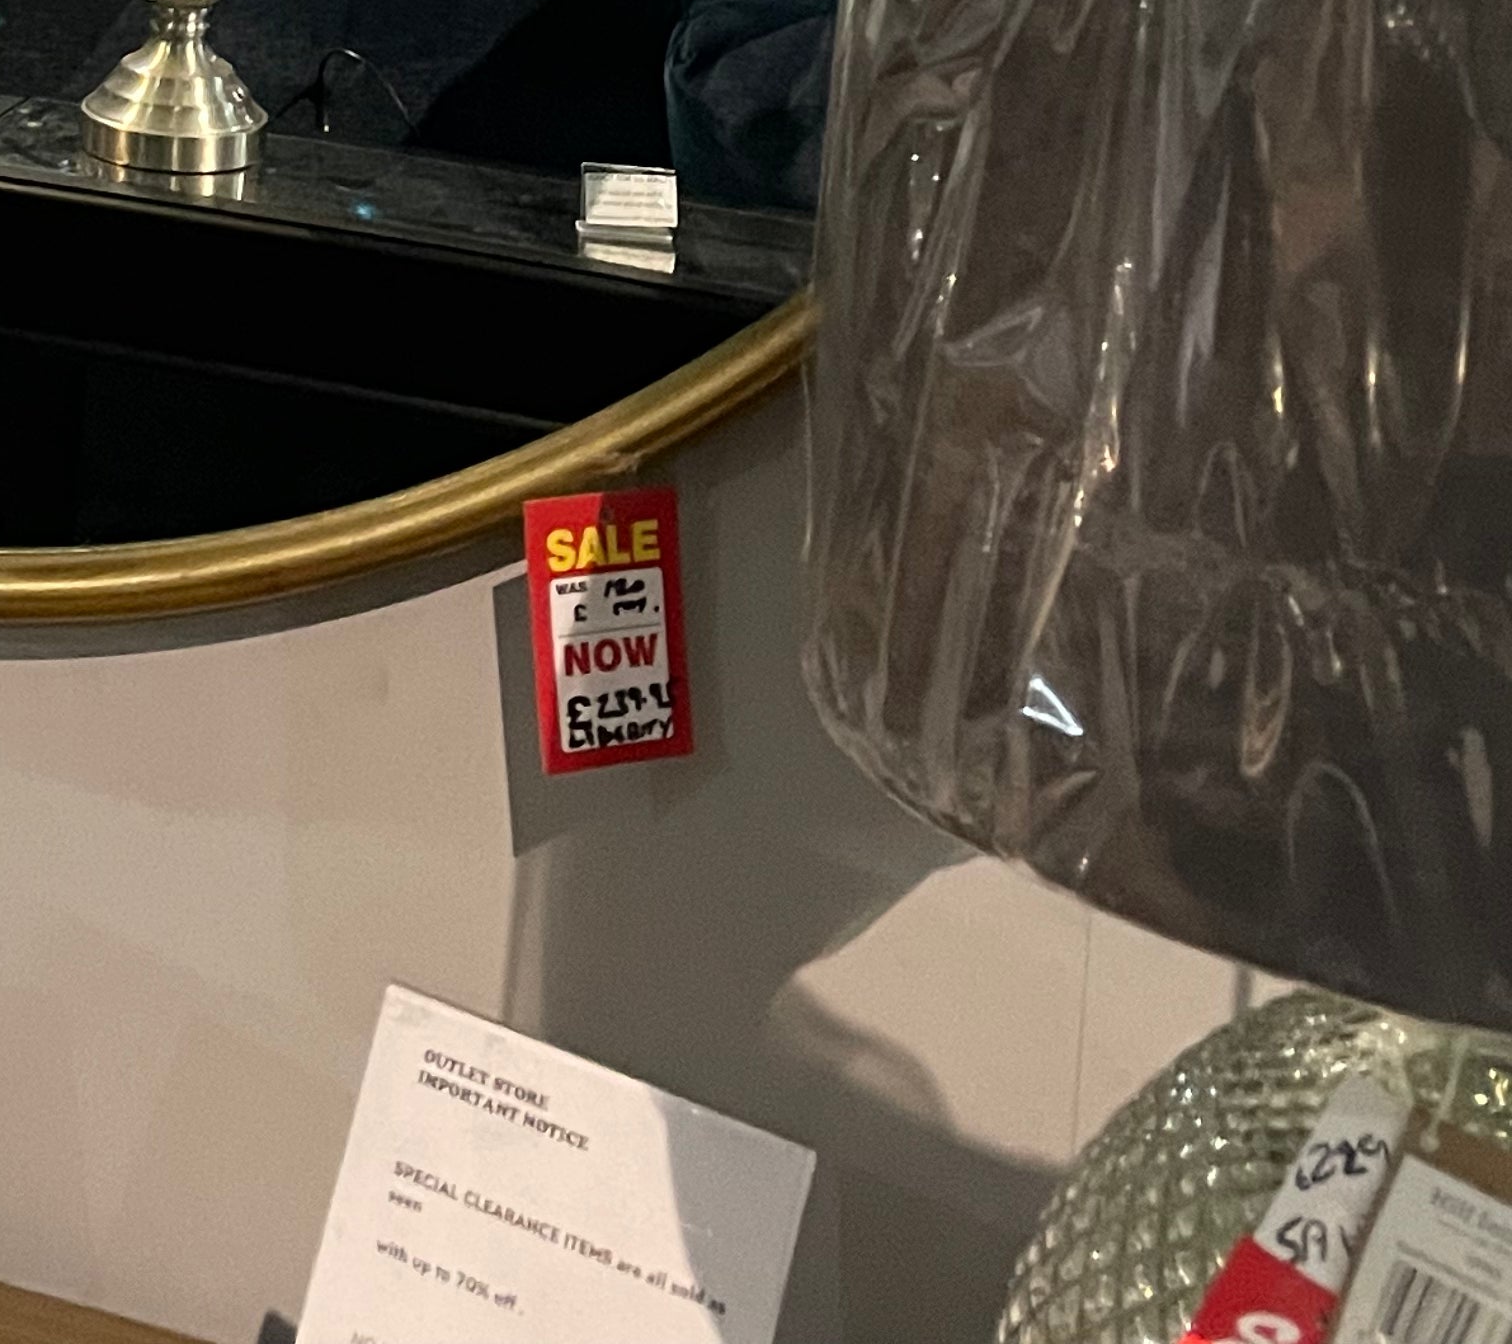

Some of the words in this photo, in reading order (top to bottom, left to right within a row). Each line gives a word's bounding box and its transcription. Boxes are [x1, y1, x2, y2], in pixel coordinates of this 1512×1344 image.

[546, 518, 661, 573] SALE
[555, 582, 588, 595] WAS
[564, 633, 658, 677] NOW
[424, 1048, 490, 1086] OUTLET
[492, 1076, 550, 1111] STORE
[418, 1069, 522, 1124] IMPORTANT
[522, 1110, 590, 1152] NOTICE
[393, 1160, 458, 1201] SPECIAL
[463, 1188, 561, 1244] CLEARANCE
[563, 1231, 613, 1265] ITEMS
[376, 1239, 408, 1263] with
[412, 1256, 432, 1277] up
[455, 1269, 490, 1300] 70%
